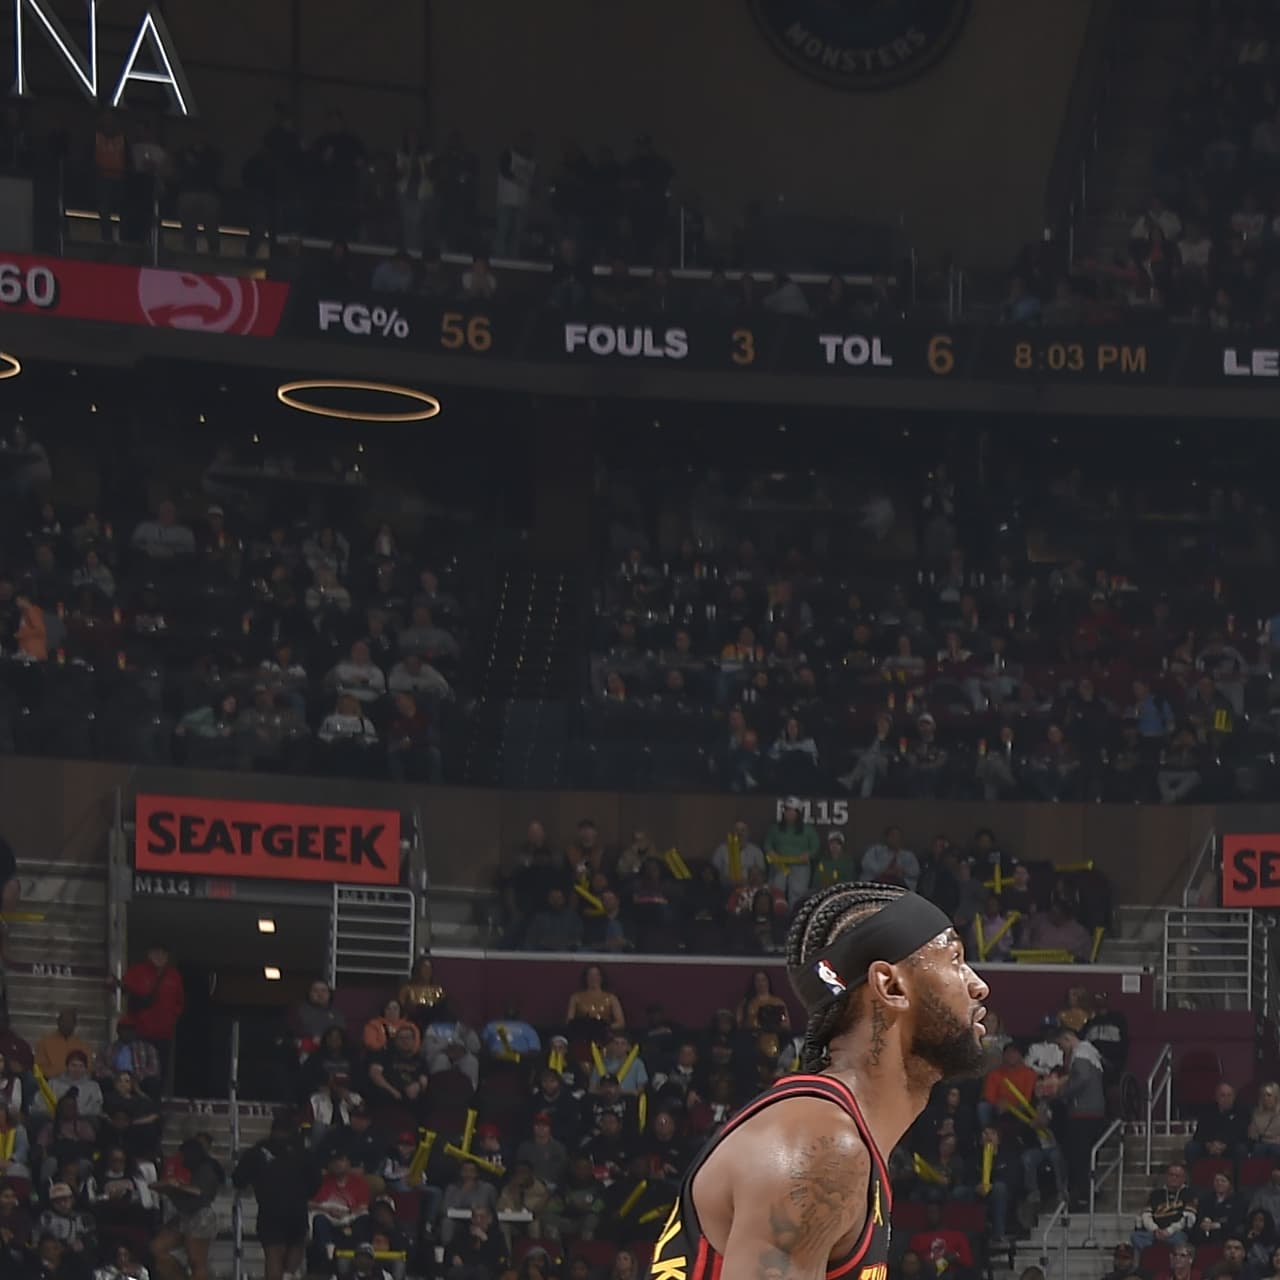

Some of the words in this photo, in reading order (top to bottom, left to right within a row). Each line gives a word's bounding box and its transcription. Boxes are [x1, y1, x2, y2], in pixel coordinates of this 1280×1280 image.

[784, 20, 927, 72] MONSTERS
[0, 263, 56, 307] 60
[318, 301, 410, 340] FG%
[440, 312, 492, 352] 56
[565, 323, 689, 360] FOULS
[730, 328, 756, 364] 3
[819, 334, 893, 366] TOL
[926, 335, 954, 374] 6
[1013, 342, 1085, 371] 8:03
[1097, 344, 1147, 373] PM
[147, 811, 386, 870] SEATGEEK
[135, 876, 191, 896] M114
